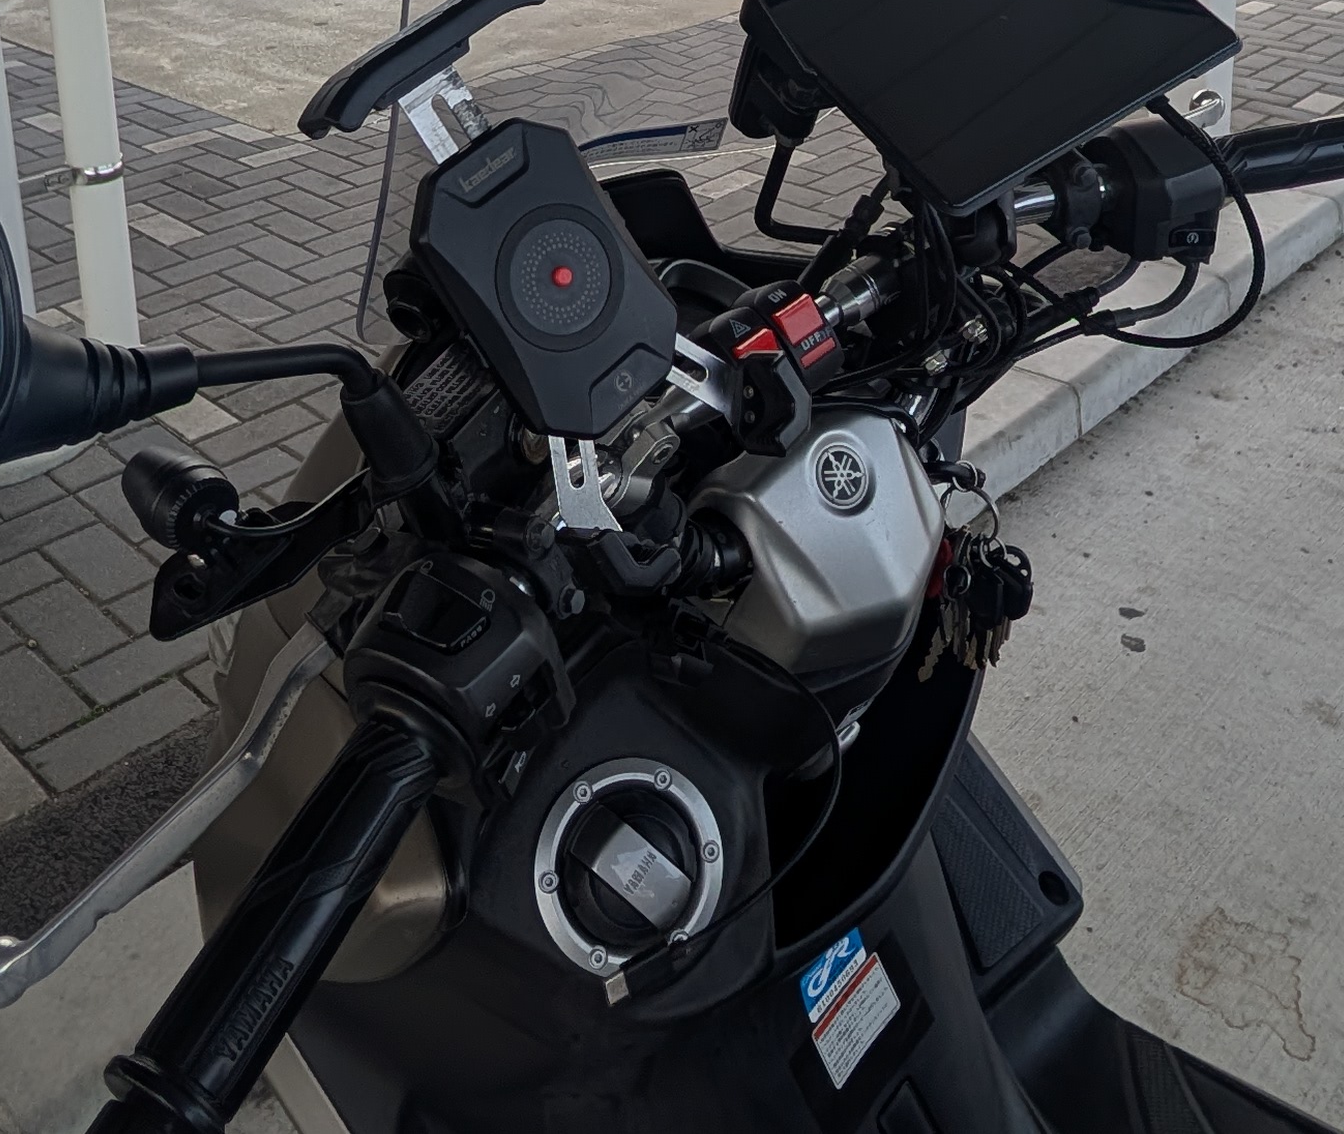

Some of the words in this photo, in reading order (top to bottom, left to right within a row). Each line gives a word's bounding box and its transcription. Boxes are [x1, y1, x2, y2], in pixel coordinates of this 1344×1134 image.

[459, 147, 517, 193] kaedear
[767, 288, 787, 303] ON
[460, 625, 483, 648] PASS
[623, 850, 657, 895] YAMAHA
[216, 957, 295, 1062] YAMAHA
